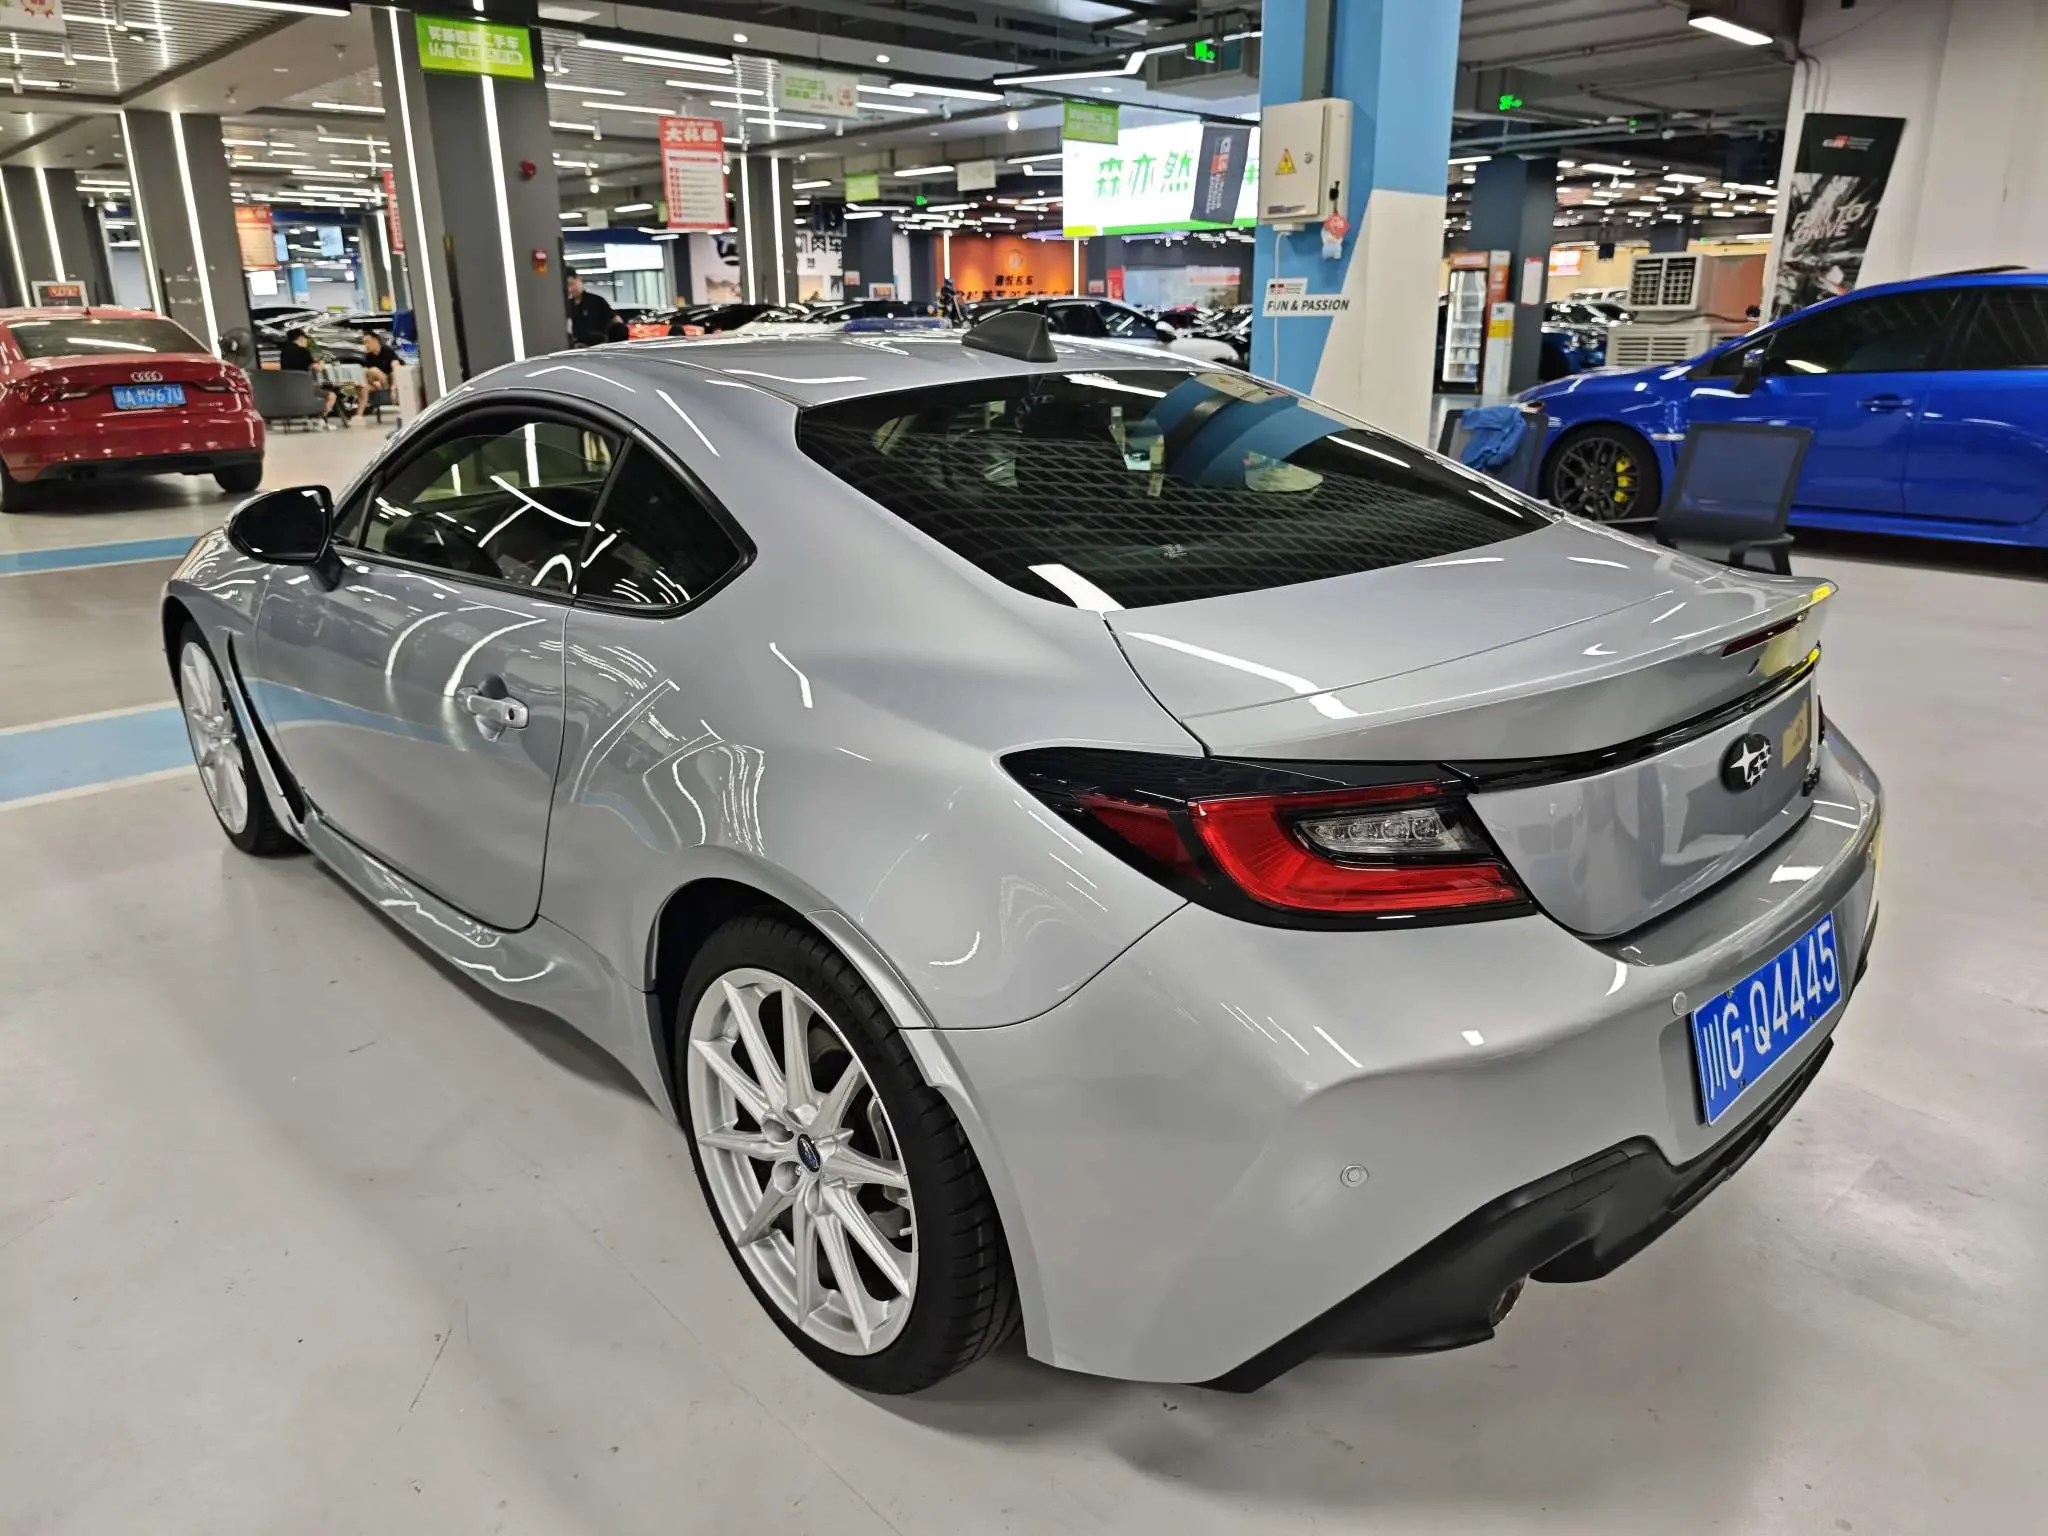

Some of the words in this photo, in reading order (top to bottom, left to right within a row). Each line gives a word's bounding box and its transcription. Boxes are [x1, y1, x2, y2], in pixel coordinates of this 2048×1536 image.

[1267, 300, 1289, 311] FUN
[1290, 300, 1299, 311] &
[1301, 300, 1350, 311] PASSION
